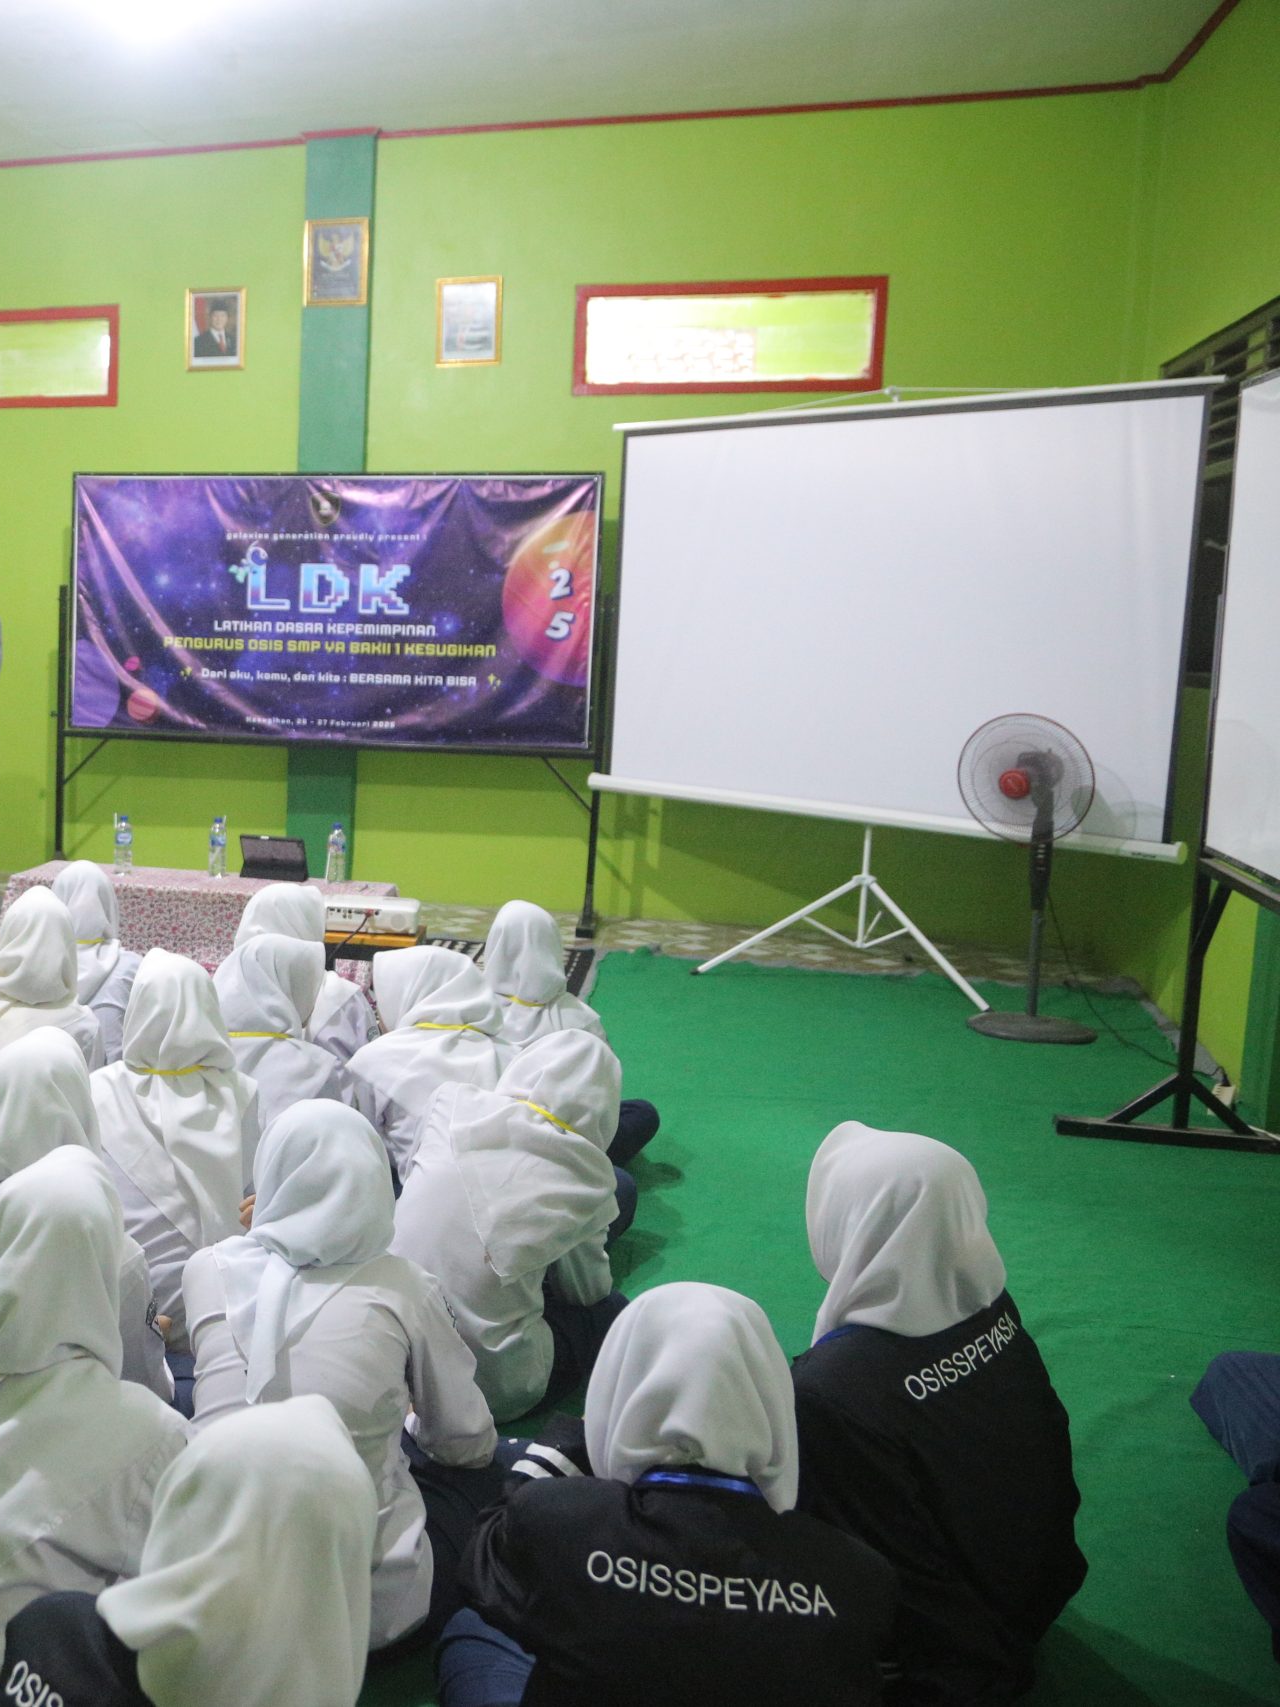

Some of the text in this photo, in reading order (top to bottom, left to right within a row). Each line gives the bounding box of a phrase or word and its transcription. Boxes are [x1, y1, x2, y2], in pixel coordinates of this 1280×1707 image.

[273, 531, 330, 542] generation
[333, 532, 375, 542] proudly
[246, 562, 411, 615] LDK
[213, 620, 436, 637] LATIHAN DASAR KEPEMIMPINAN
[163, 636, 497, 658] PENGURUS OSIS SMP YA BAKII 1 KESUGIHAN
[201, 668, 227, 679] Dari
[229, 669, 254, 681] aku,
[256, 669, 291, 682] kamu,
[293, 671, 315, 682] dan
[318, 671, 341, 683] kita
[349, 673, 411, 686] BERSAMA
[414, 674, 443, 686] KITA
[446, 675, 477, 687] BISA
[904, 1311, 1019, 1401] OSISSPEYASA
[586, 1550, 837, 1617] OSISSPEYASA
